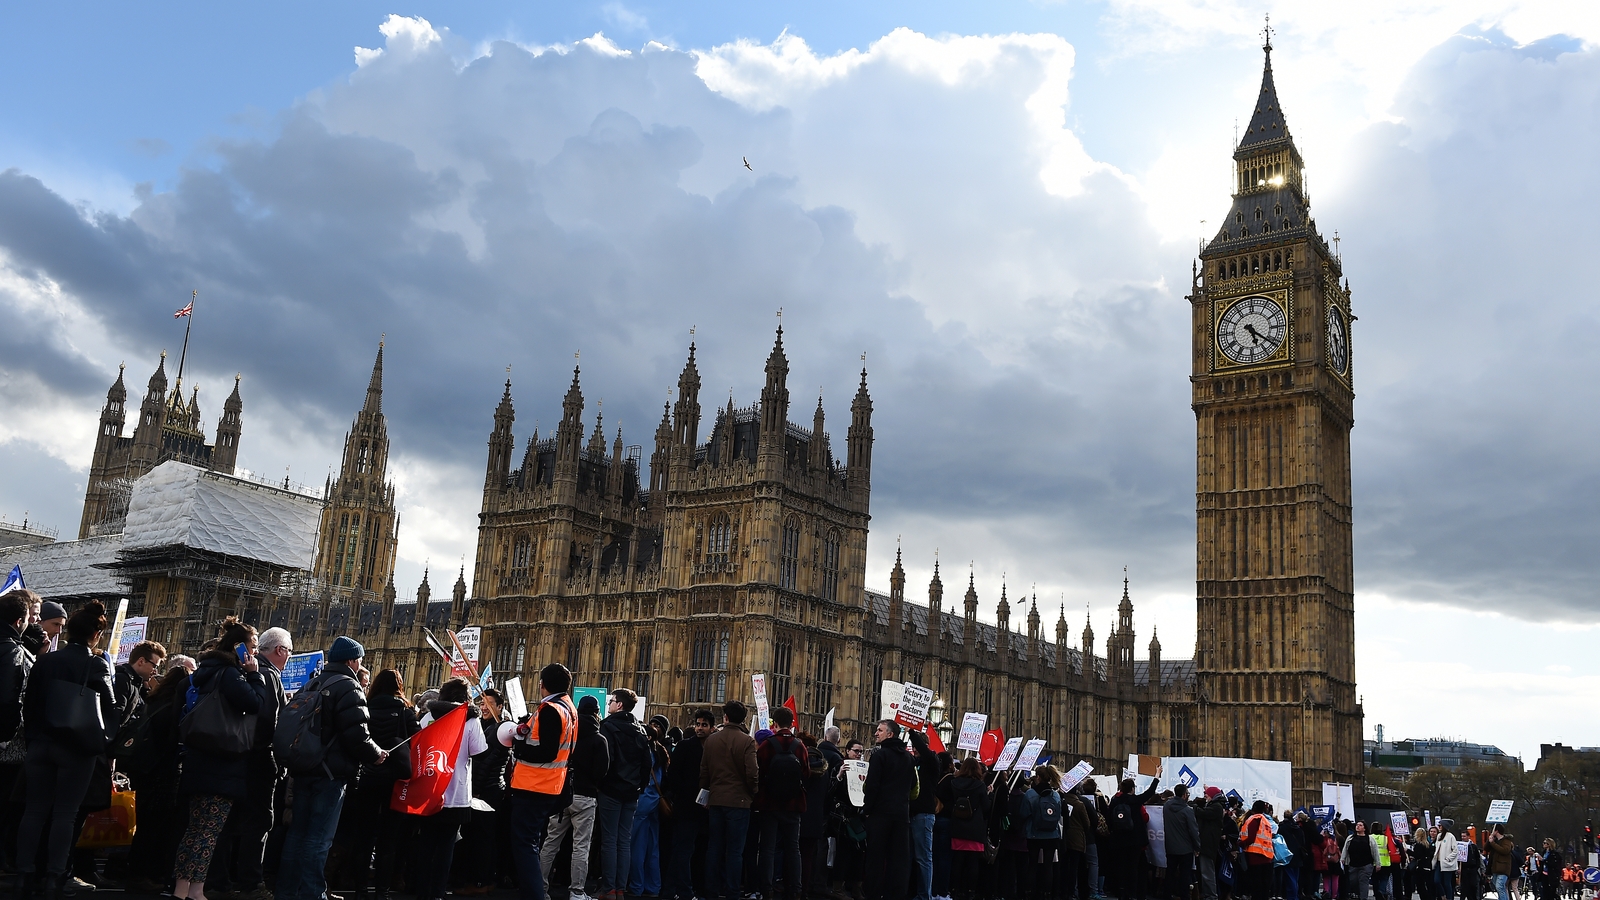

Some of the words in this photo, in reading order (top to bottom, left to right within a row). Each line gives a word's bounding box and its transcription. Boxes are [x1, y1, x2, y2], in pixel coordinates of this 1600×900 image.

[471, 633, 479, 642] to
[904, 687, 923, 700] Victory
[923, 693, 931, 702] to
[903, 695, 912, 703] the
[911, 697, 928, 709] junior
[903, 704, 923, 716] doctors
